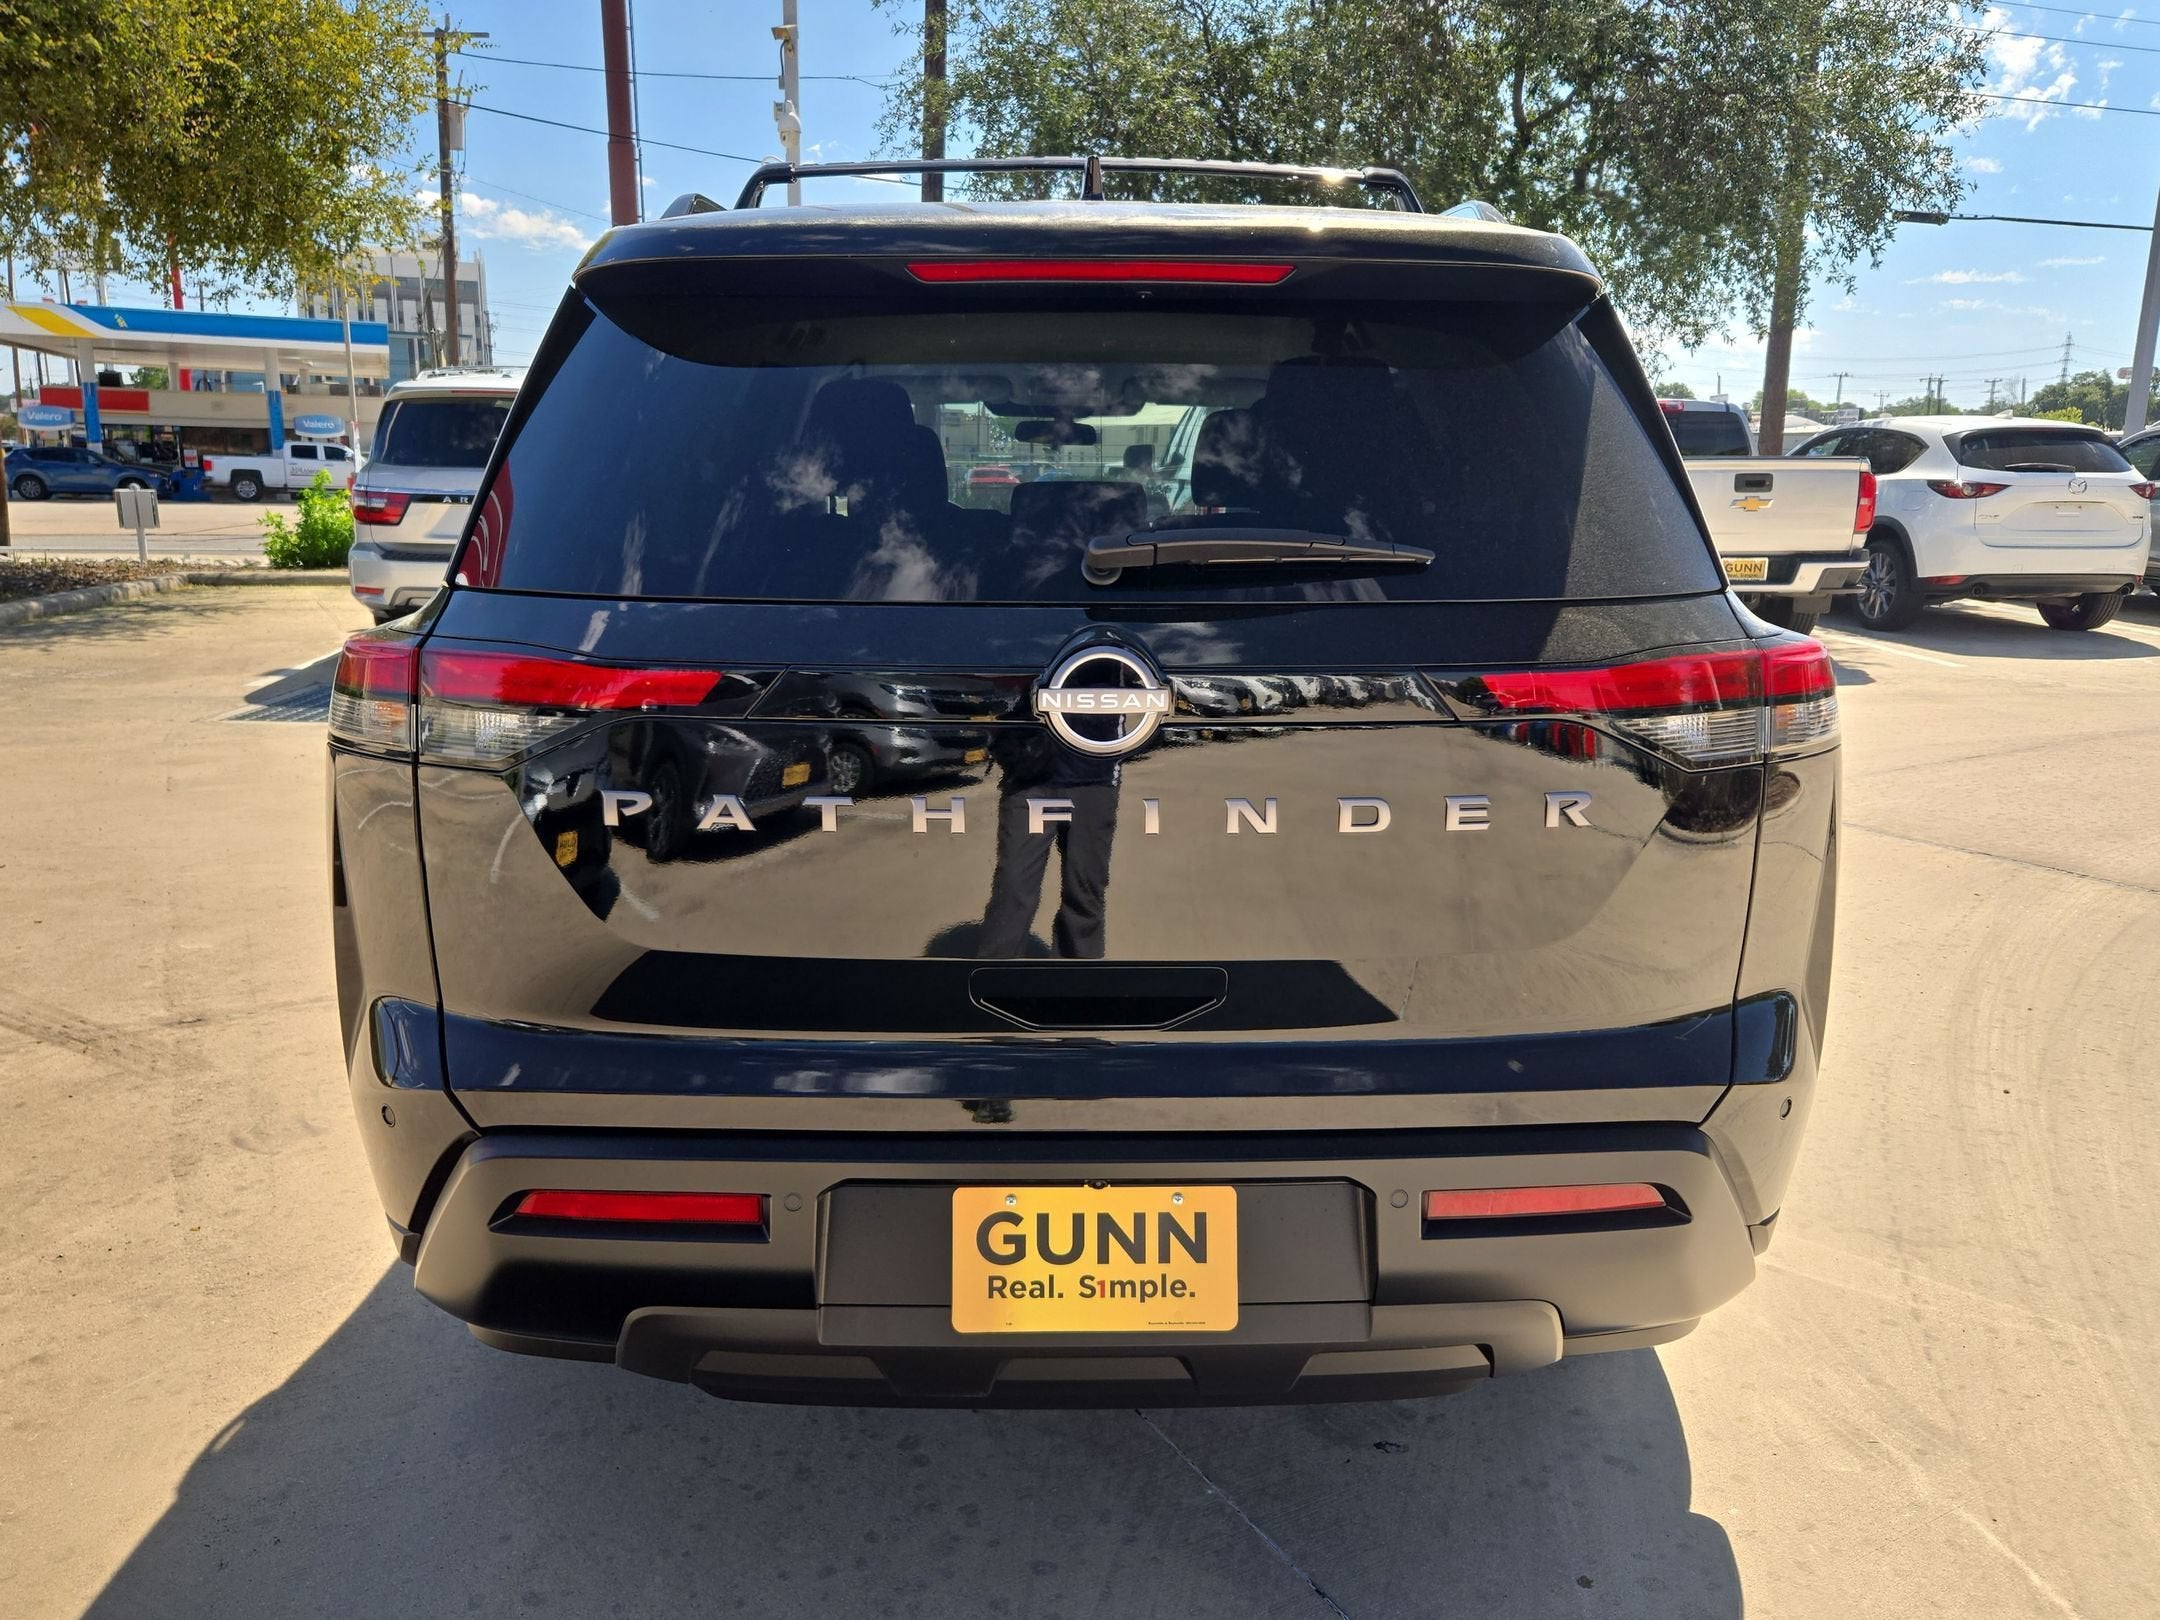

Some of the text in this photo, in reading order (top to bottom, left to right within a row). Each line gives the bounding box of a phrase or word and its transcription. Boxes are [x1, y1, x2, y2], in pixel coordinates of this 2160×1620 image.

[27, 411, 63, 421] Valero
[302, 419, 335, 430] Valero
[1725, 563, 1763, 573] GUNN
[1042, 692, 1164, 709] NISSAN
[601, 789, 1593, 836] PATHFINDER
[976, 1210, 1208, 1266] GUNN
[987, 1274, 1064, 1299] Real.
